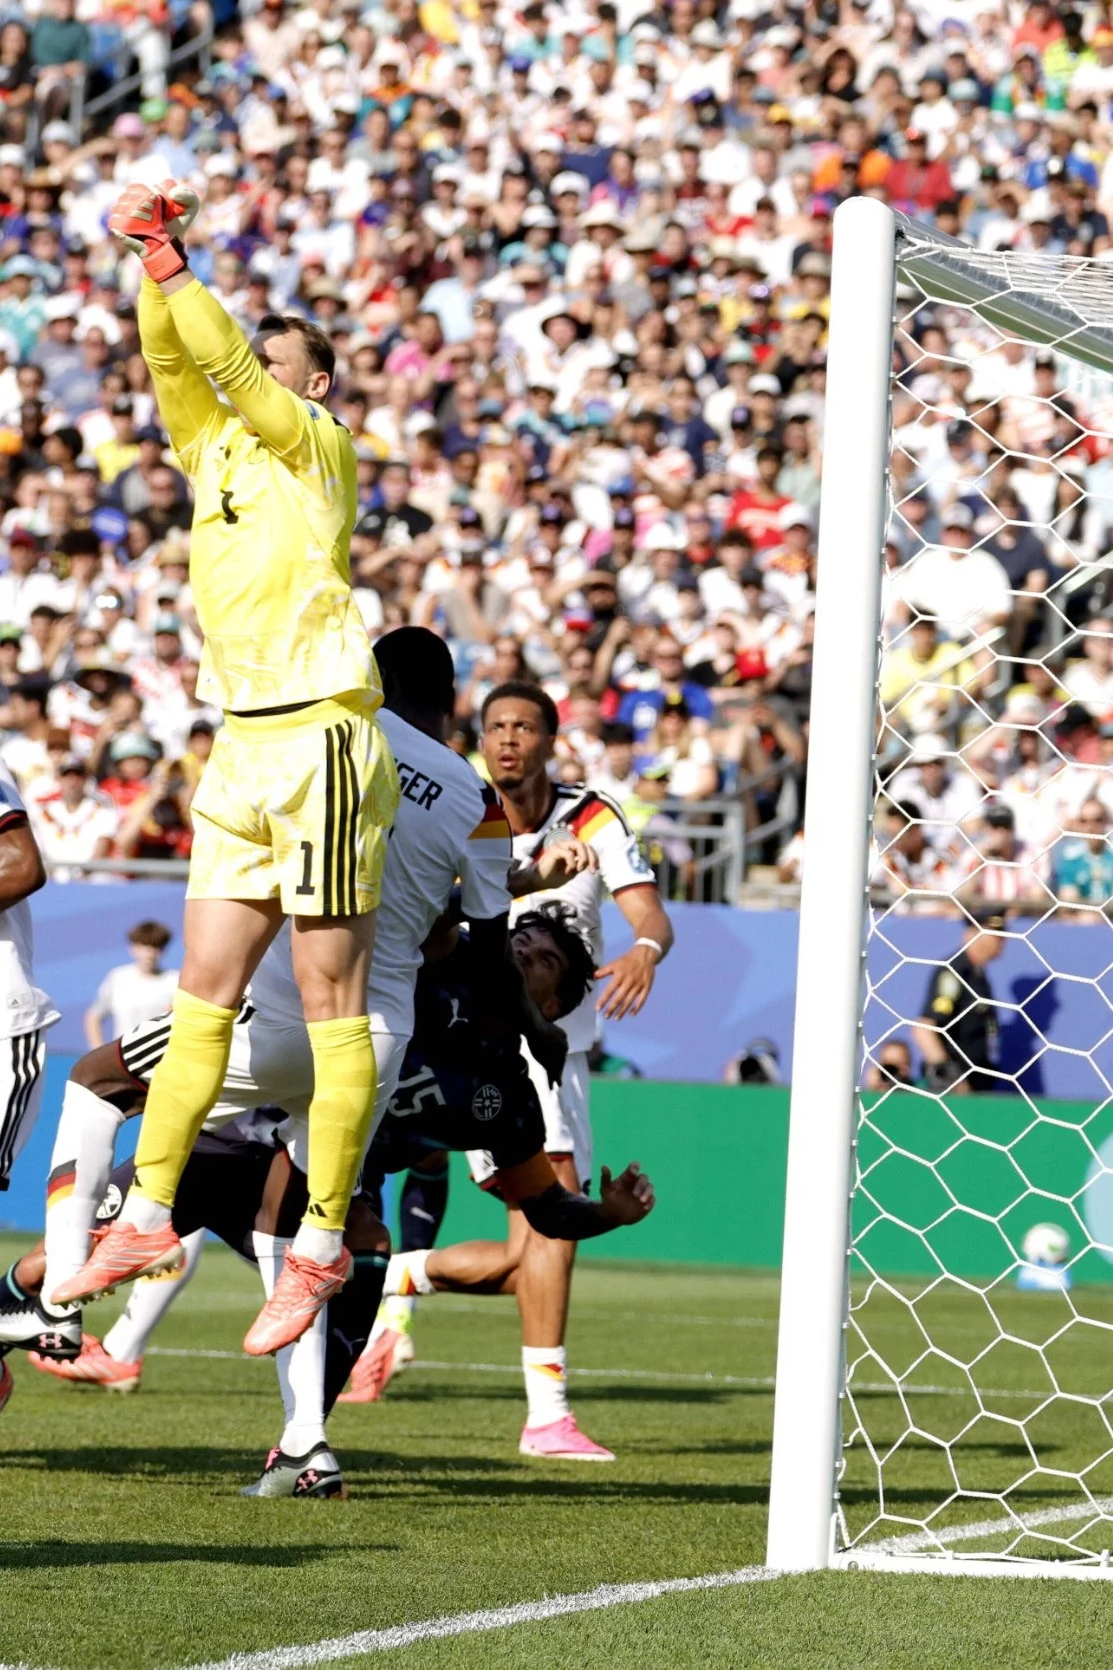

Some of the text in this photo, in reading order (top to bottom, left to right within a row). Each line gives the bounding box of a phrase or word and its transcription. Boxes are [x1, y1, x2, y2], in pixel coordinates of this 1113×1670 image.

[394, 758, 443, 811] GER
[296, 841, 315, 895] 1
[388, 1065, 447, 1117] 15
